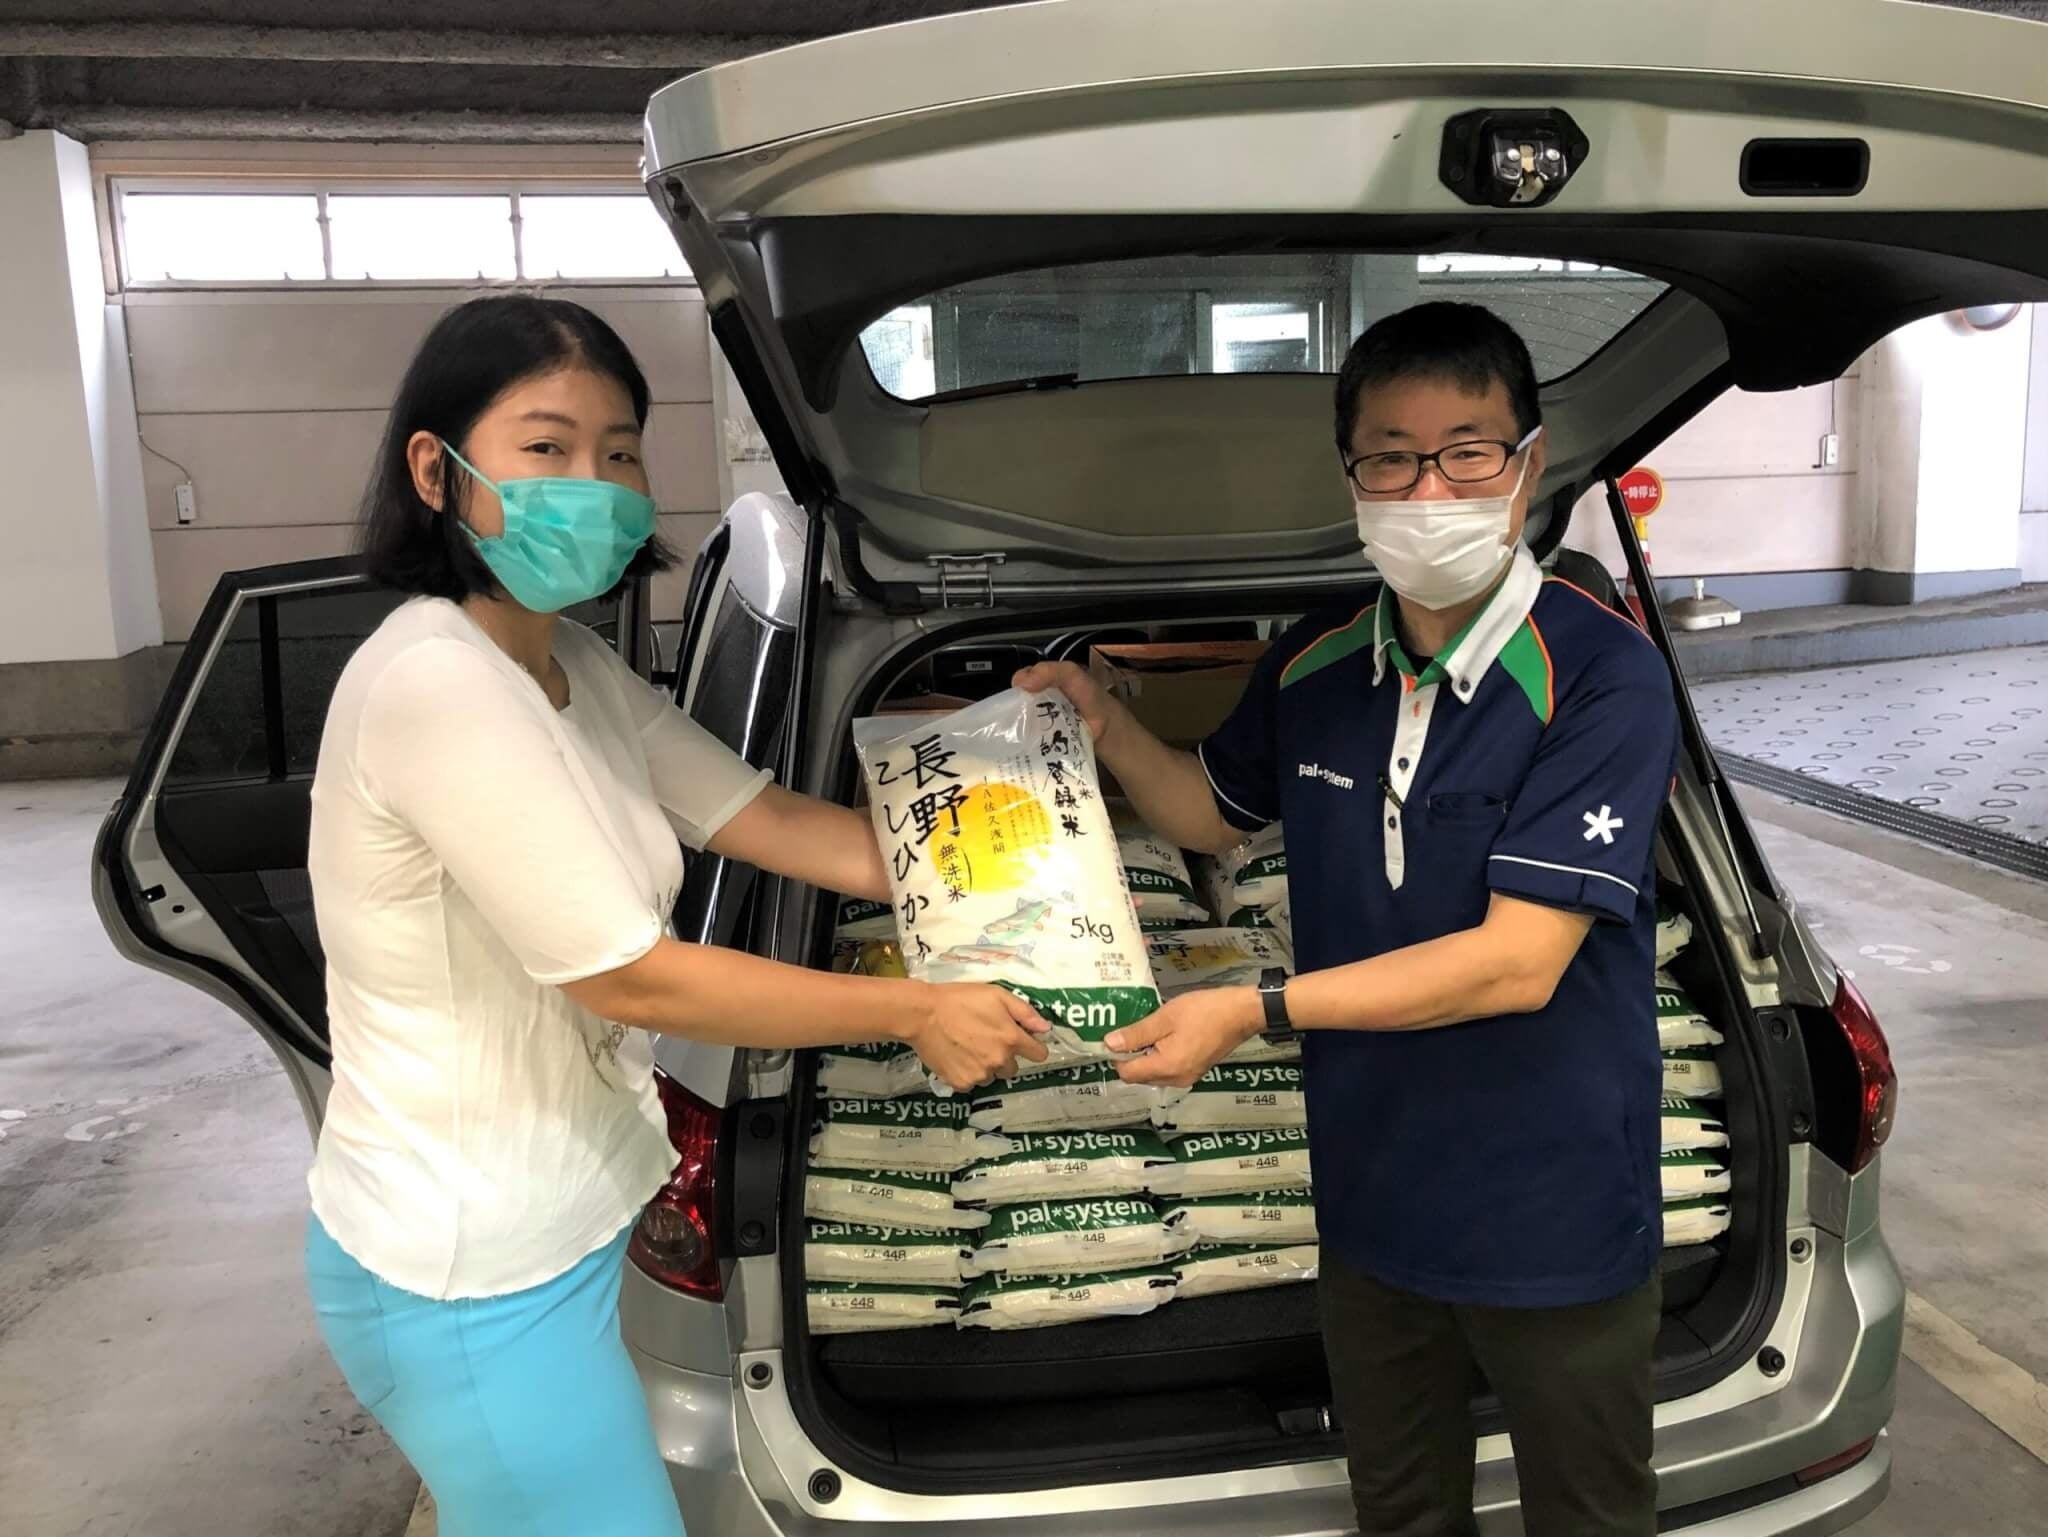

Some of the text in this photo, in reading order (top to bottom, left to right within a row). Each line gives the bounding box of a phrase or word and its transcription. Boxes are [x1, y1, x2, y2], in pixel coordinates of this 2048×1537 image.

[902, 734, 969, 845] 長野
[1144, 844, 1172, 862] 5kg
[938, 843, 967, 904] 無洗米
[1070, 914, 1114, 944] 5kg
[1253, 1094, 1277, 1105] 448
[1064, 1161, 1088, 1173] 448
[1256, 1156, 1280, 1168] 448
[868, 1186, 894, 1199] 448
[1260, 1209, 1281, 1220] 448
[1083, 1233, 1105, 1243] 448
[882, 1248, 907, 1260] 448
[1255, 1254, 1279, 1266] 448
[1068, 1289, 1091, 1301] 448
[850, 1297, 875, 1309] 448
